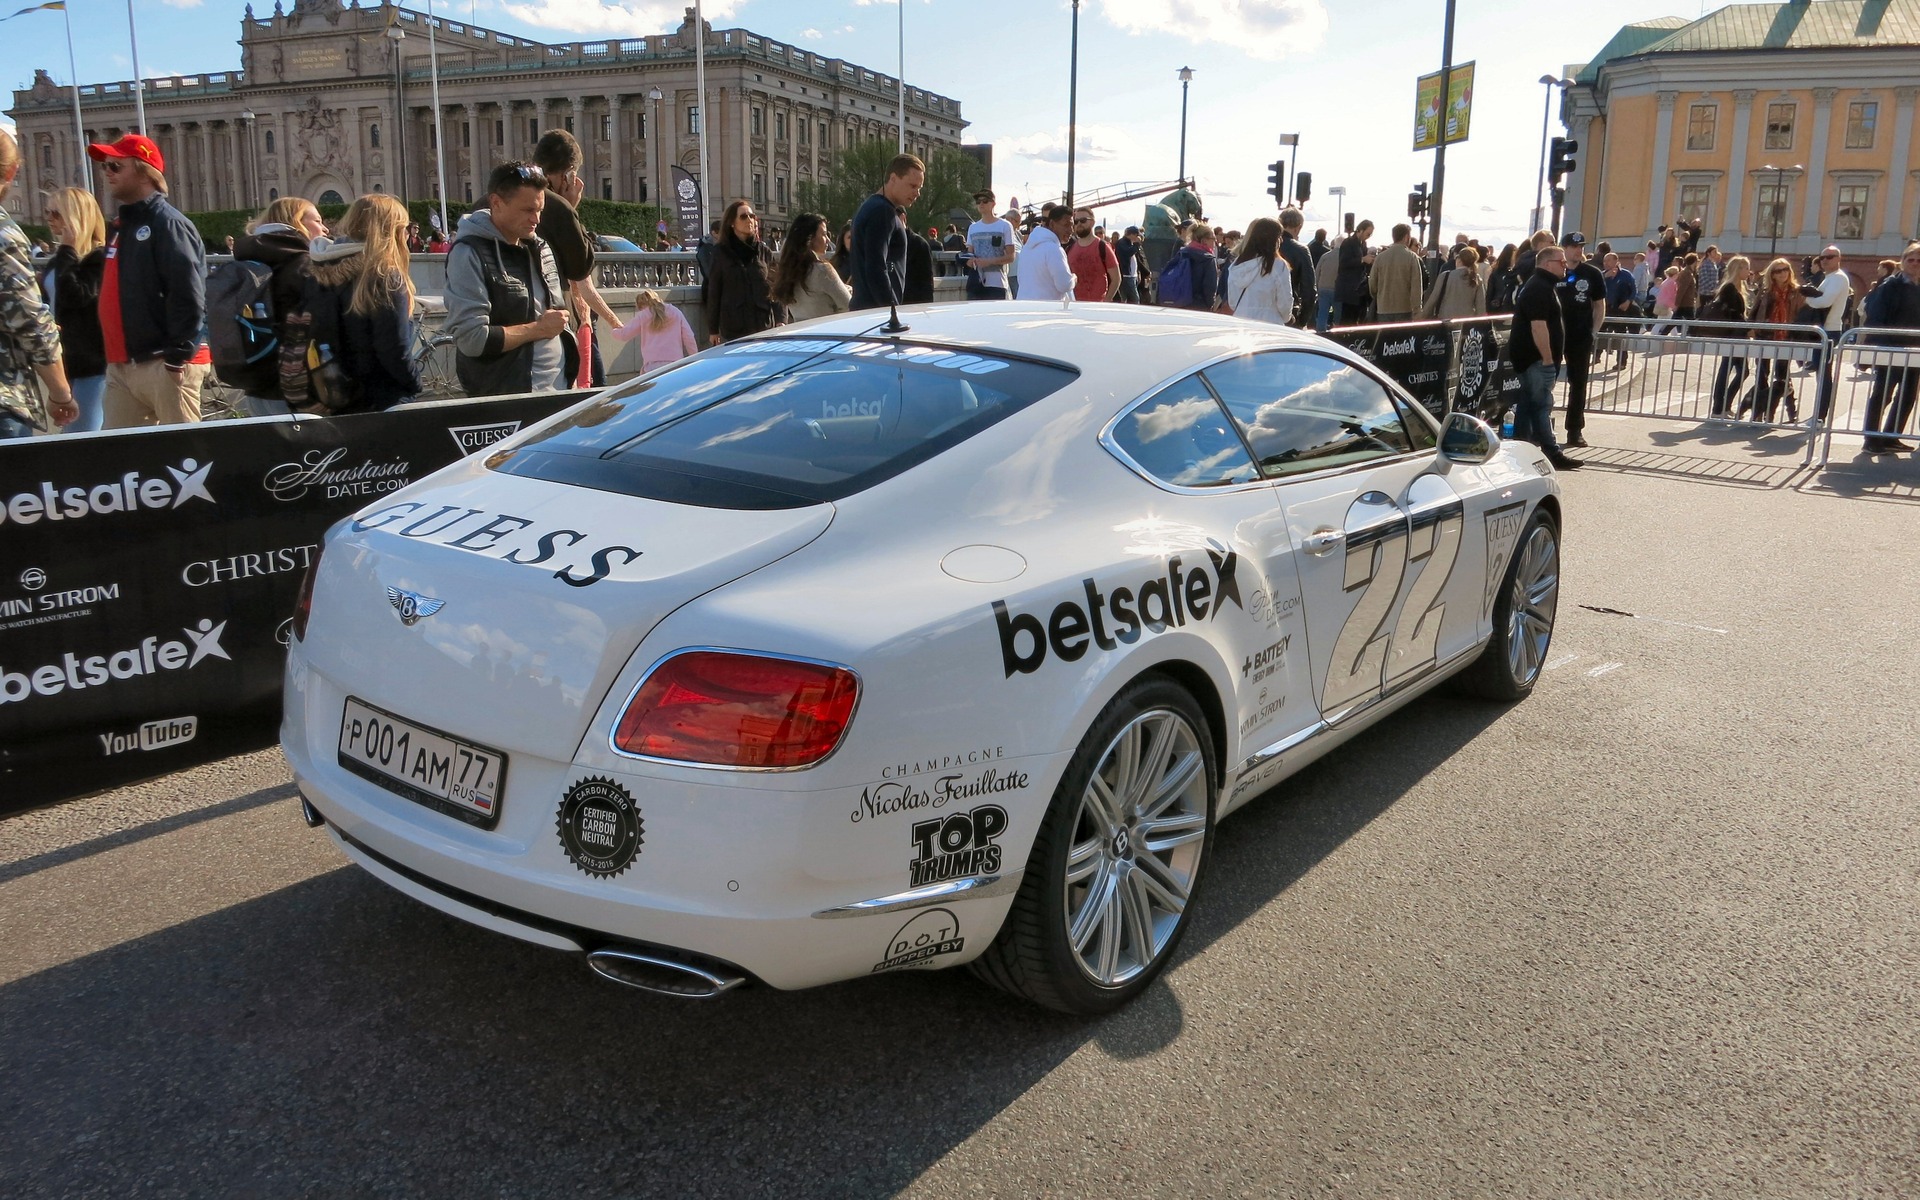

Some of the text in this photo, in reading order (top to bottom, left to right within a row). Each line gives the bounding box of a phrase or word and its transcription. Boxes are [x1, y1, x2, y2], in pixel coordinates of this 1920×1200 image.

[884, 346, 1010, 374] 3000
[462, 428, 508, 447] GUESS
[263, 447, 409, 501] Anastasia
[327, 478, 409, 499] DATE.COM
[1489, 513, 1518, 542] GUESS
[351, 502, 643, 587] GUESS
[40, 583, 120, 611] STROM
[1321, 473, 1464, 713] 22
[8, 618, 35, 628] WATCH
[36, 608, 92, 624] MANUFACTURE
[991, 555, 1212, 679] betsafe
[0, 636, 188, 704] betsafe
[100, 720, 193, 756] YouTube
[459, 749, 488, 789] 77
[882, 747, 1003, 778] CHAMPAGNE
[452, 784, 475, 802] RUS
[576, 786, 628, 810] CARBON ZERO
[850, 769, 1030, 823] Nicolas Feuillatte
[582, 818, 616, 836] CARBON
[583, 807, 617, 823] CERTIFIED
[581, 830, 615, 847] NEUTRAL
[912, 804, 1009, 864] TOP
[579, 853, 614, 869] 2015-2016
[910, 844, 1002, 888] TRUMPS
[874, 946, 937, 971] SHIPPED
[940, 940, 962, 952] BY
